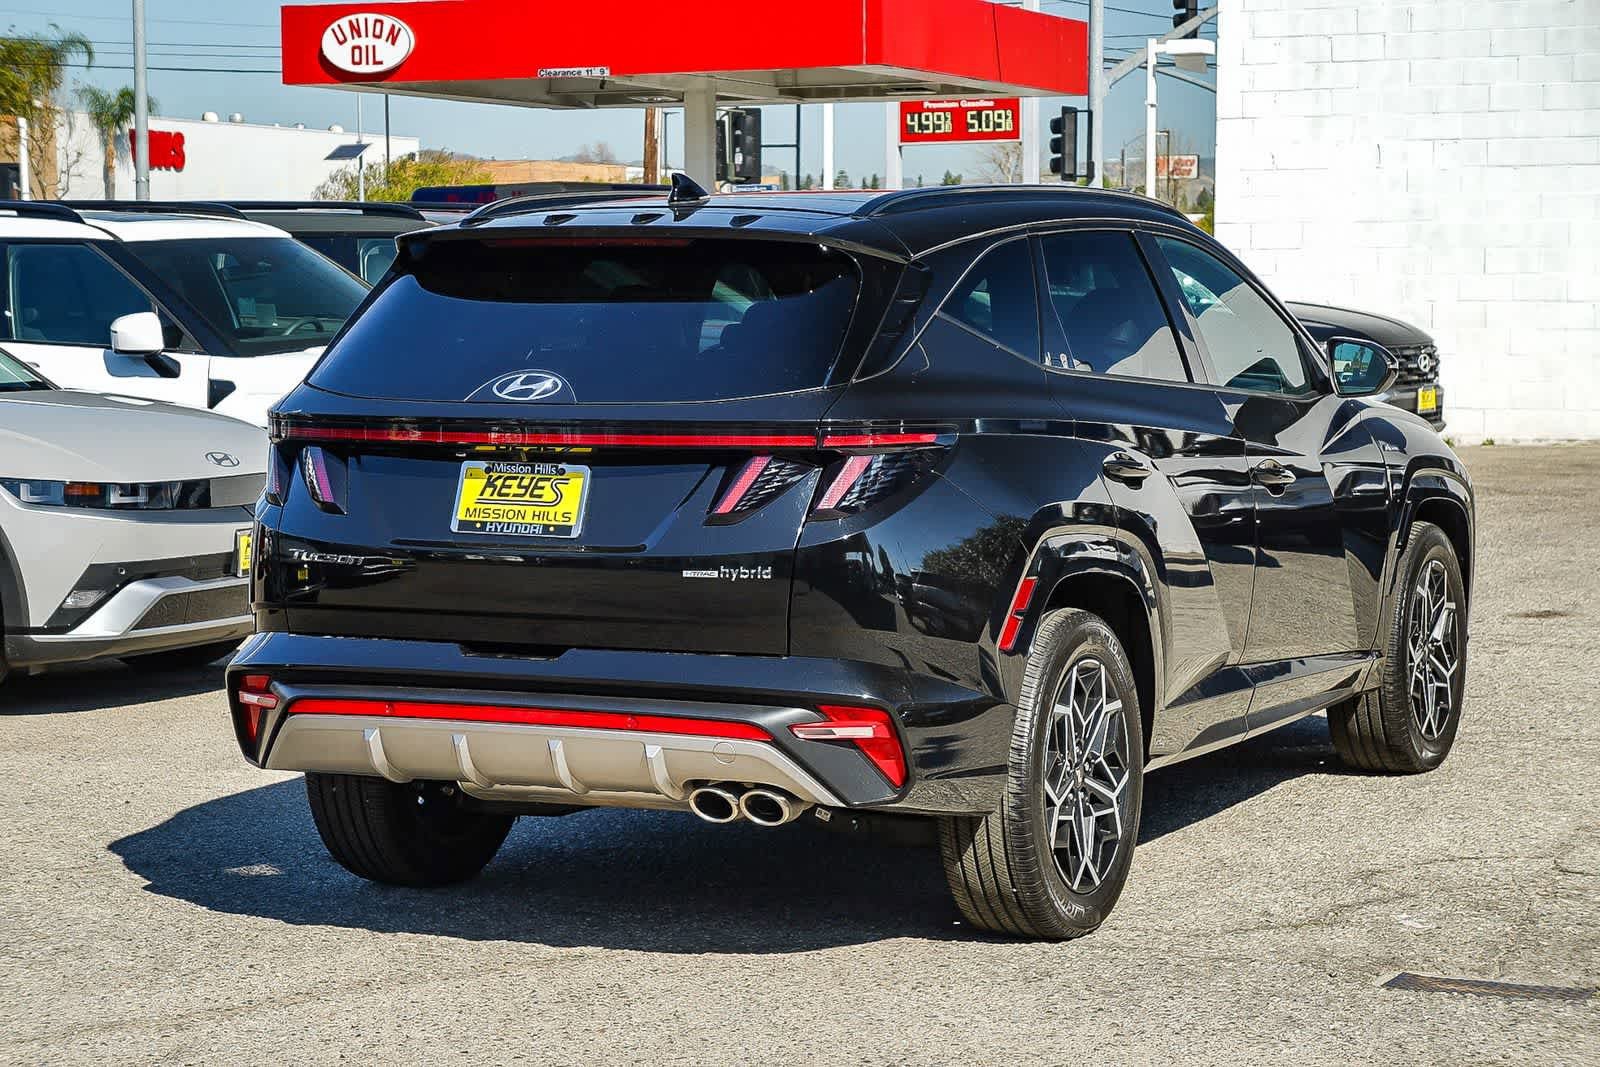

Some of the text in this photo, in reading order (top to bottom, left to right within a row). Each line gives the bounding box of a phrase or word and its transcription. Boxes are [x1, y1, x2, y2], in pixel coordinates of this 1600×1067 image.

[331, 17, 402, 46] UNION
[351, 45, 384, 66] OIL
[539, 69, 582, 77] Clearance
[493, 463, 557, 476] Mission Hills
[475, 474, 570, 507] KEYES
[464, 507, 572, 523] MISSION HILLS
[485, 522, 544, 535] HYUNDAI
[720, 565, 772, 582] hybrid
